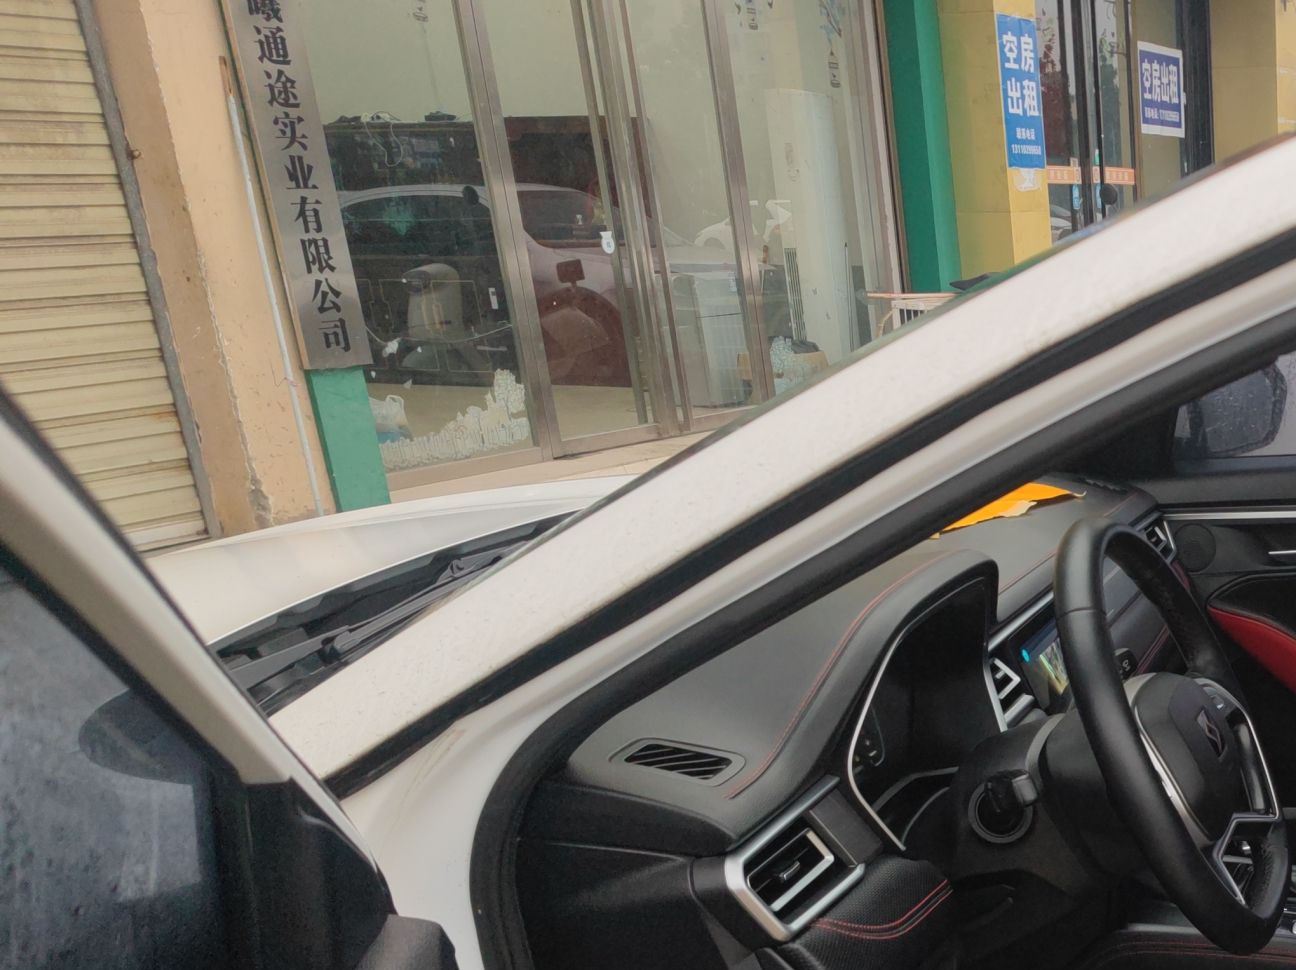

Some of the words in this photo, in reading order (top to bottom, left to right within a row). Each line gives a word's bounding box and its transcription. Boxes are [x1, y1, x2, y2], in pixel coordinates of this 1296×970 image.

[1002, 31, 1035, 73] 空房
[1007, 77, 1040, 118] 出租
[1141, 59, 1179, 104] 空房出租
